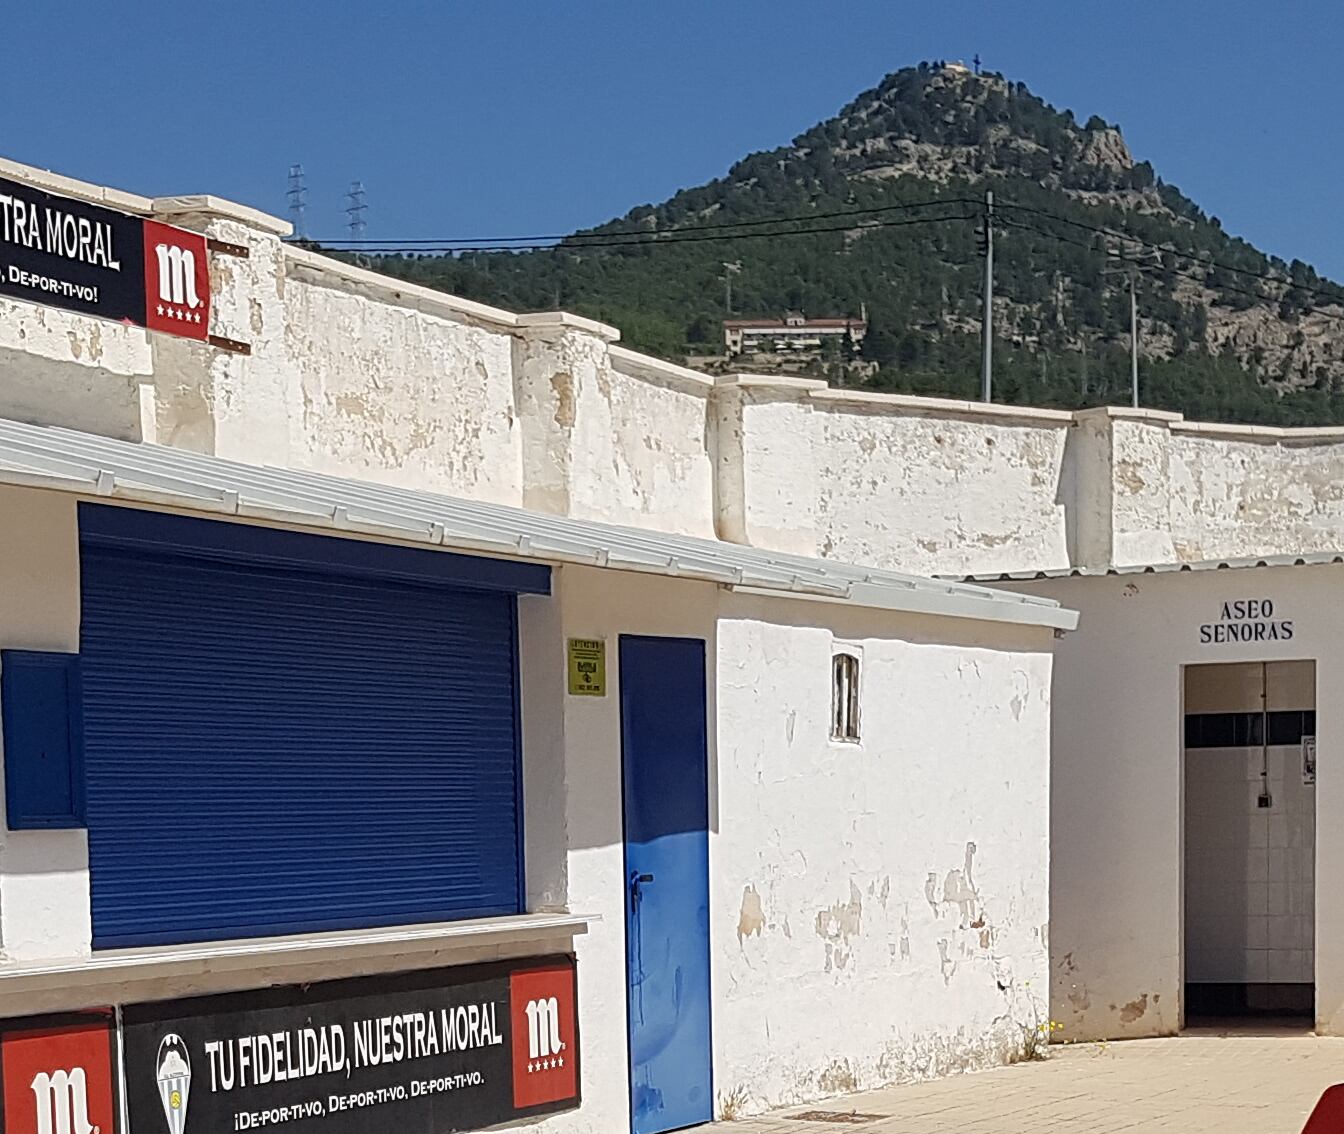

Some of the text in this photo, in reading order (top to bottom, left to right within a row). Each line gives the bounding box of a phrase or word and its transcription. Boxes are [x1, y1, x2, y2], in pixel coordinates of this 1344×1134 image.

[45, 207, 121, 272] MORAL
[1221, 599, 1273, 620] ASEO
[204, 1001, 503, 1093] TU FIDELIDAD, NUESTRA MORAL
